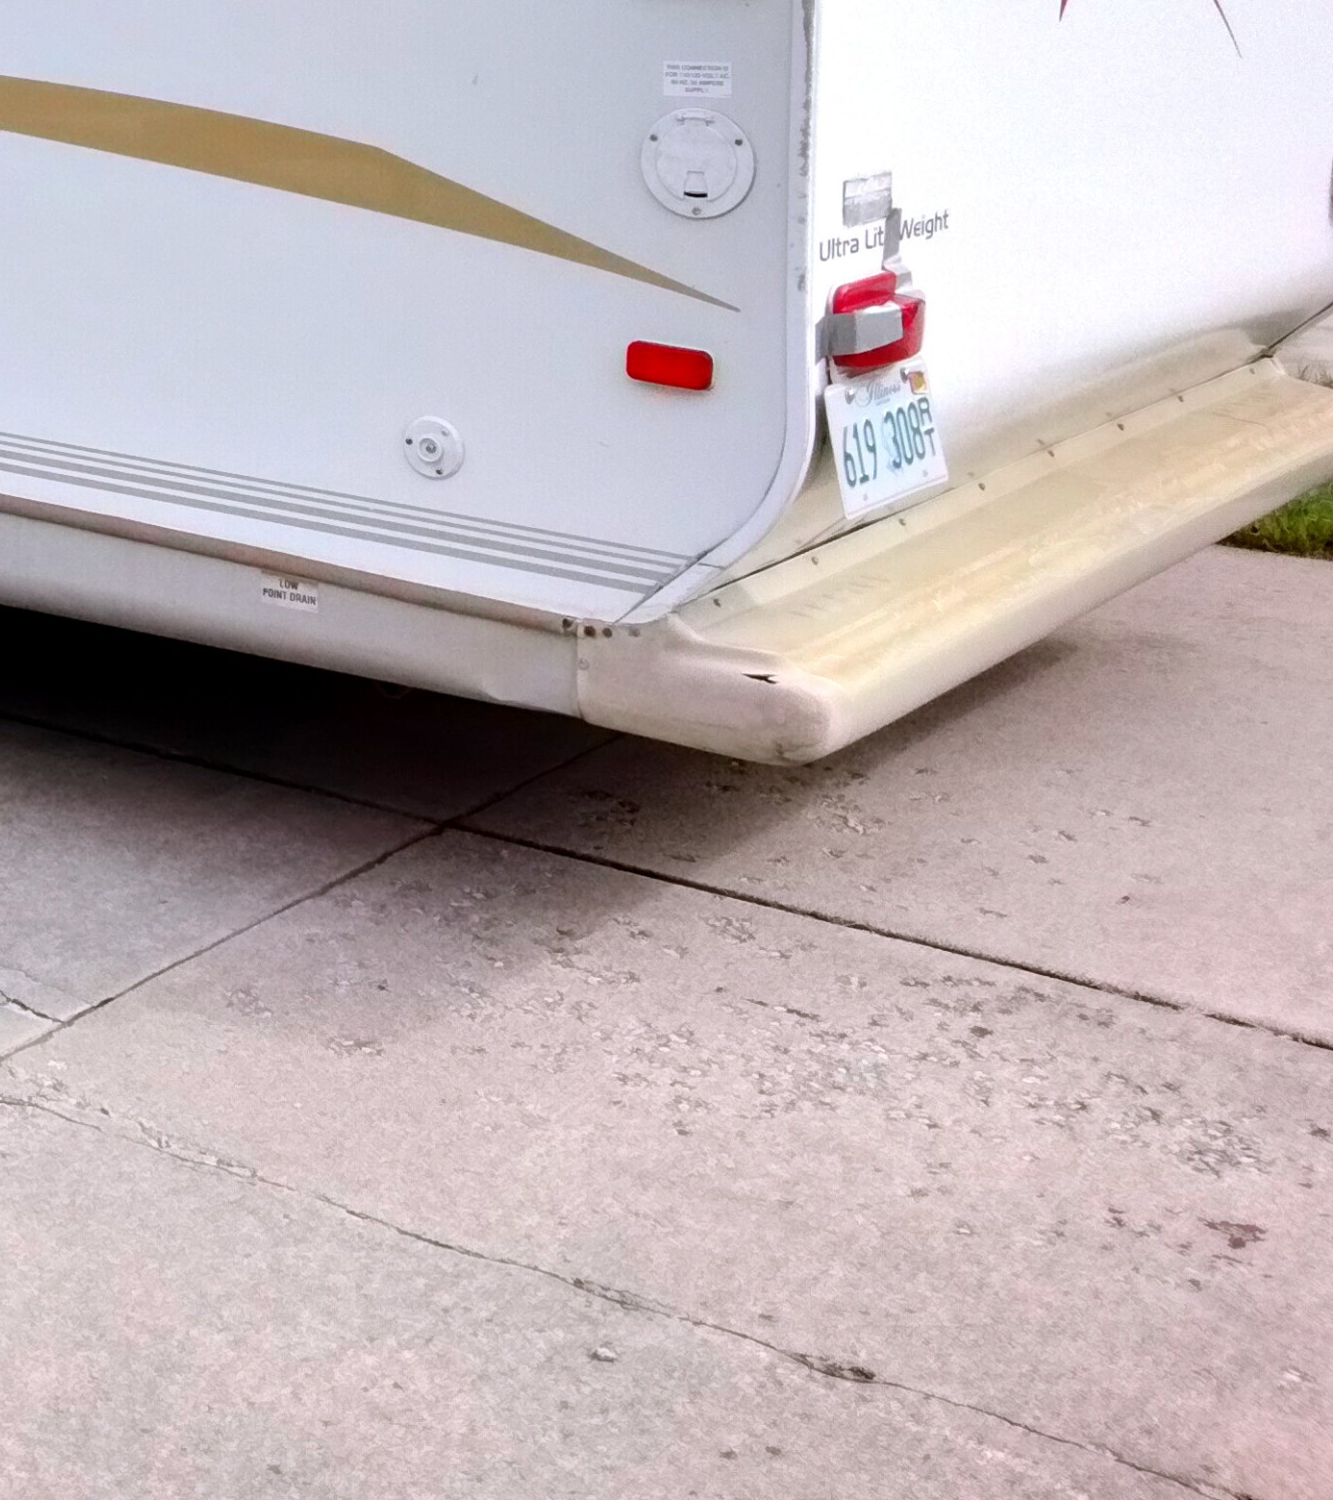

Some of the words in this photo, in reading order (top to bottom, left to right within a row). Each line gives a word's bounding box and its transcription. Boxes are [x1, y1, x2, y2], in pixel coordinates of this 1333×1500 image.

[819, 238, 860, 262] Ultra
[865, 226, 885, 249] Lit
[900, 210, 949, 240] Weight
[843, 418, 877, 488] 619
[883, 401, 927, 469] 308
[263, 587, 287, 600] POINT
[289, 592, 316, 605] DRAIN
[279, 579, 299, 590] LOW
